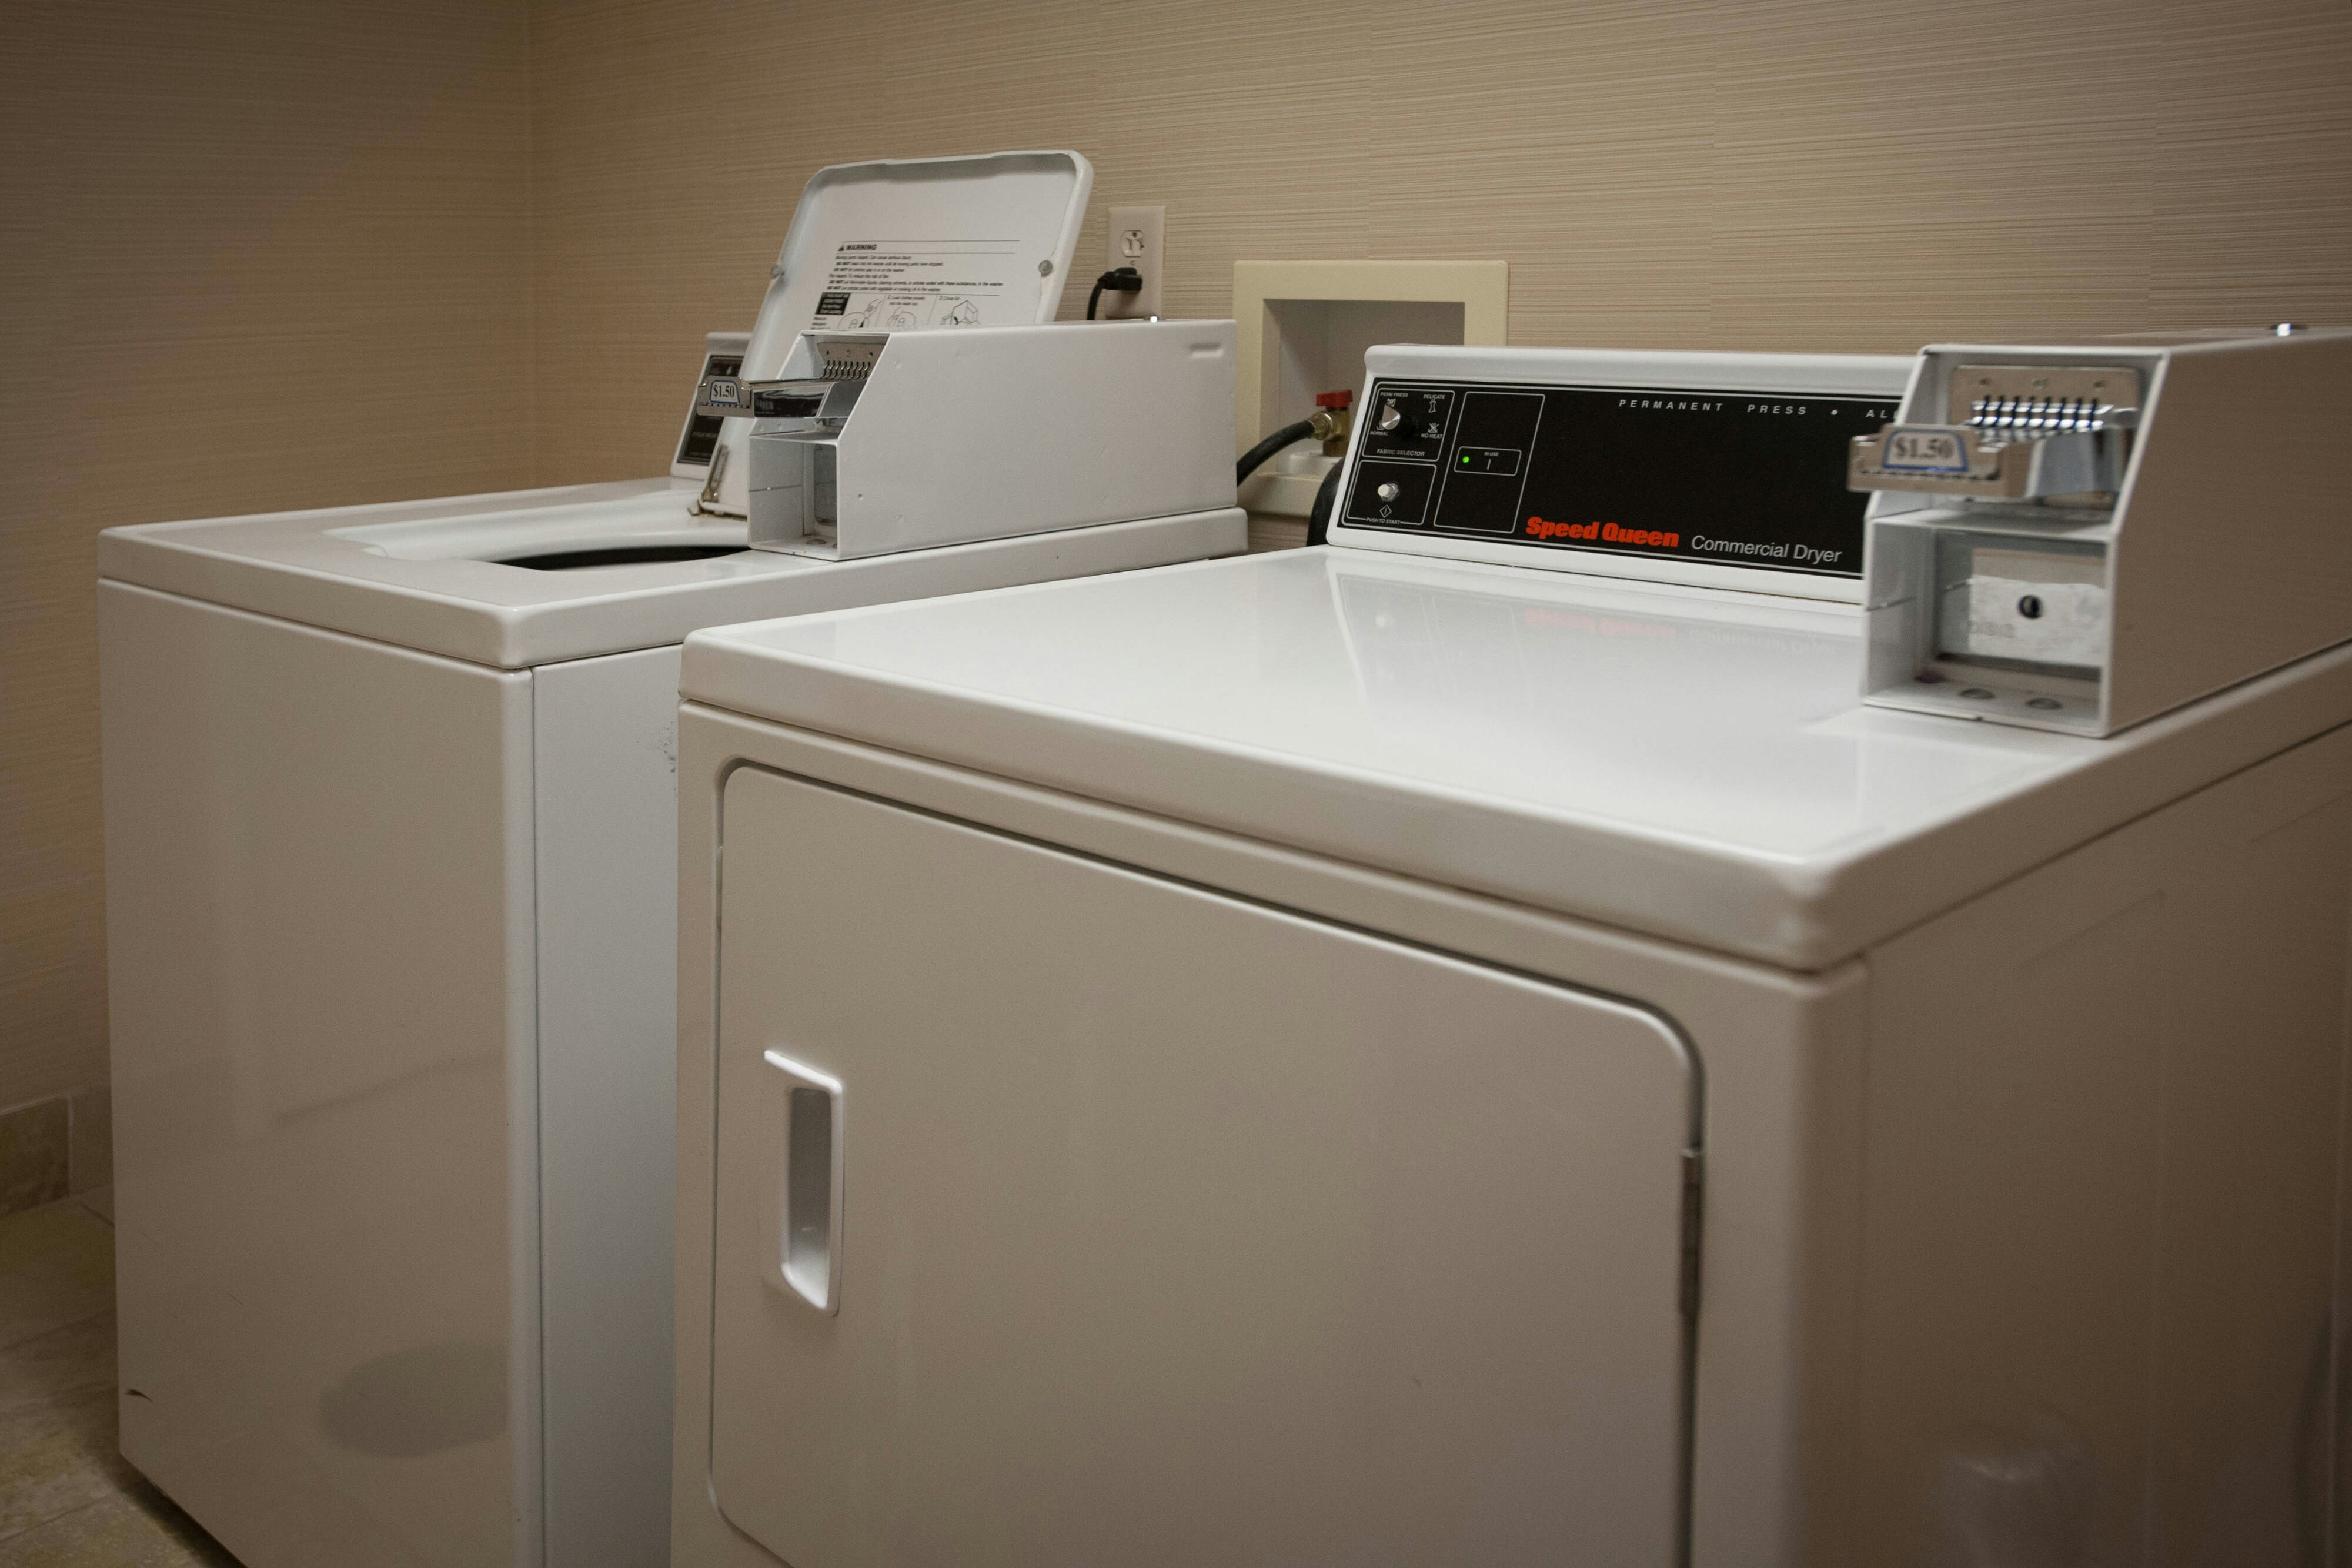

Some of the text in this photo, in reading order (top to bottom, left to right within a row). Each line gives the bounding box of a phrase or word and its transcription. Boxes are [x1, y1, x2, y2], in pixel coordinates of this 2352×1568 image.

[713, 384, 734, 397] $1.50
[1619, 399, 1723, 412] PERMANENT
[1747, 404, 1808, 416] PRESS
[1893, 437, 1953, 460] $1.50
[1525, 517, 1679, 547] Speed Queen
[1691, 535, 1842, 564] Commercial Dryer
